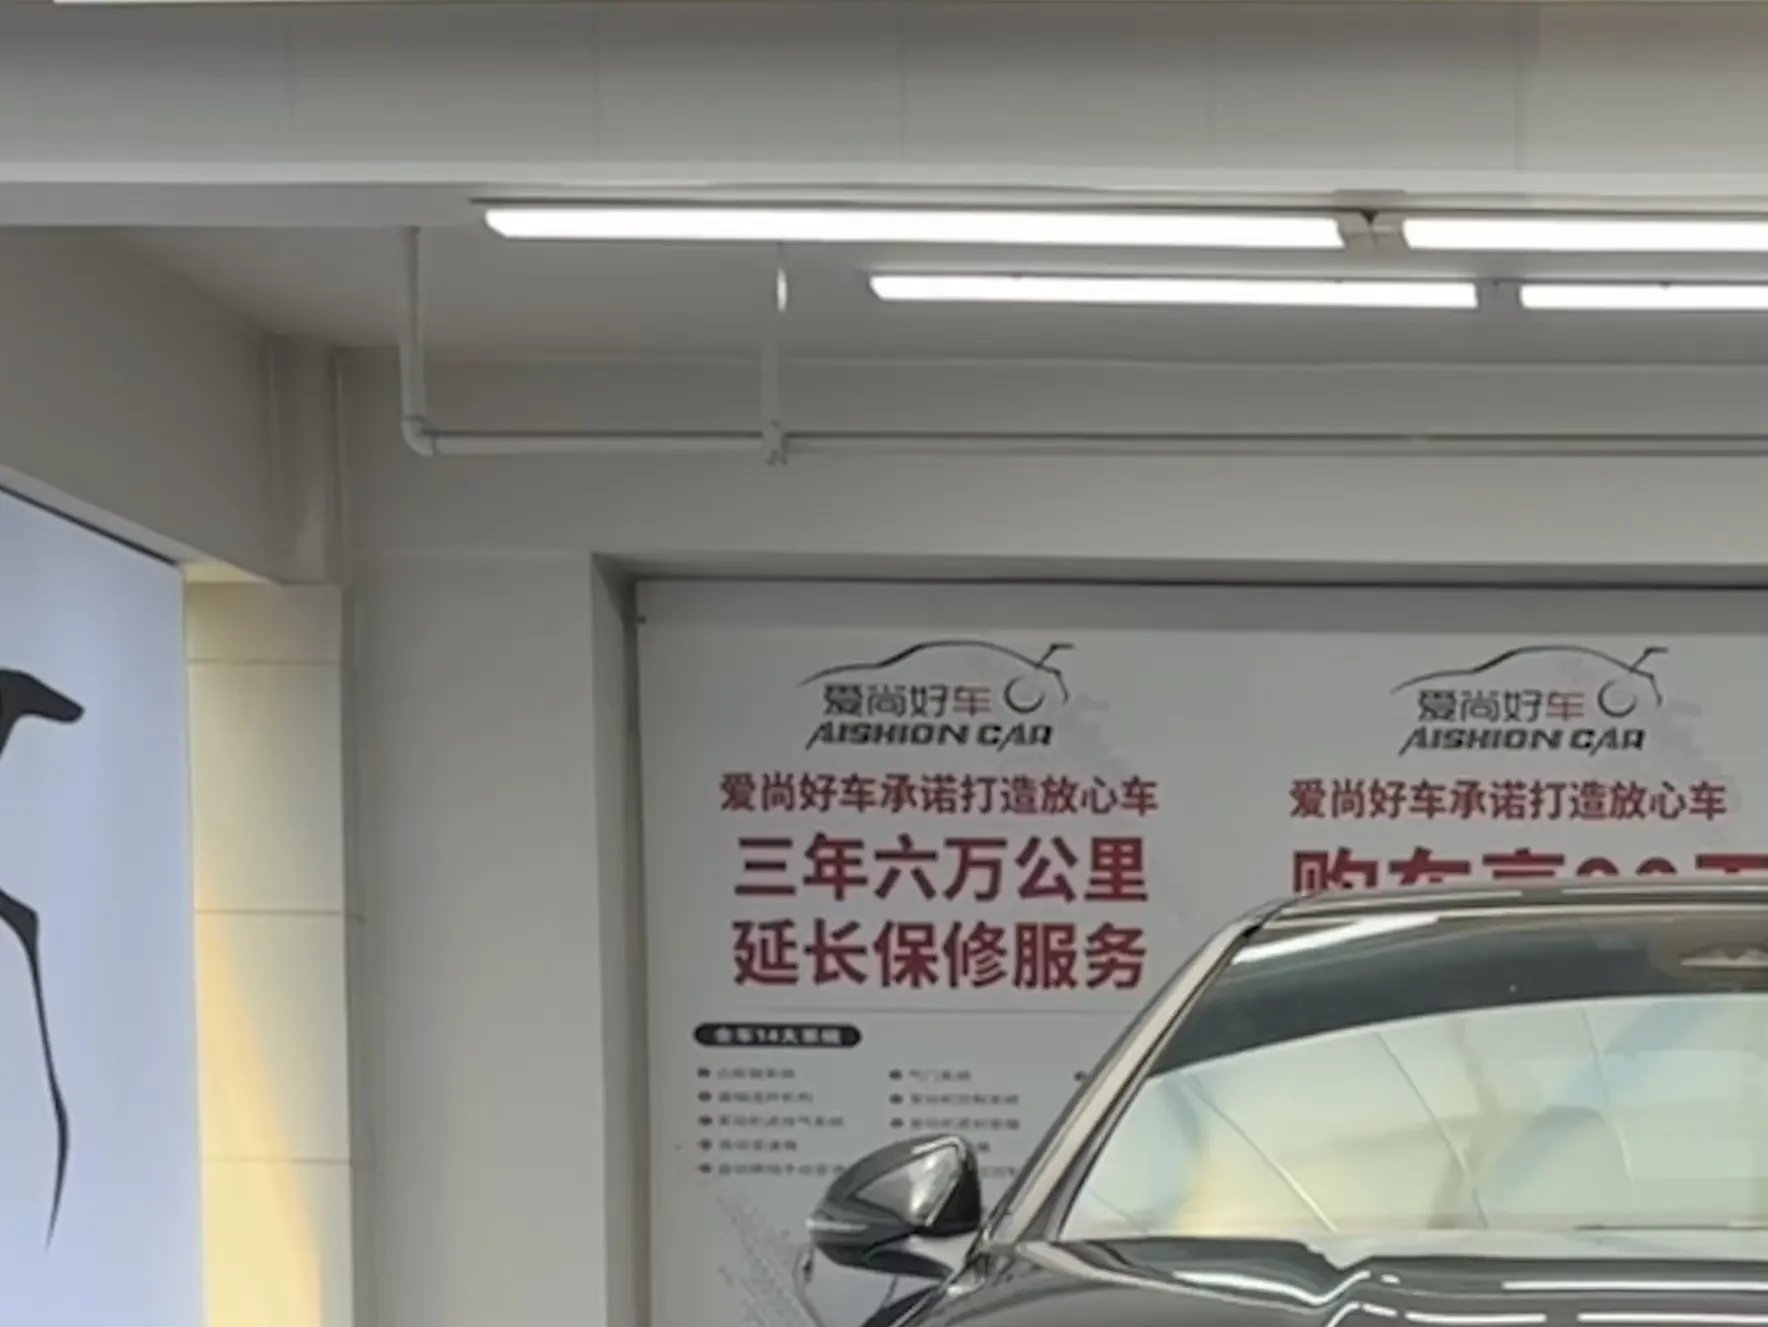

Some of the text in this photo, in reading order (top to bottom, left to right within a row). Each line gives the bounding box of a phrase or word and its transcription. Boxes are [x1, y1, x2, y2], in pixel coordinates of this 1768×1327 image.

[824, 684, 989, 717] 爱尚好车
[1419, 690, 1583, 723] 爱尚好车
[806, 721, 1053, 751] AISHION CAR
[1399, 727, 1645, 756] AISHION CAR
[719, 772, 1158, 816] 爱尚好车承诺打造放心车
[1289, 778, 1727, 820] 爱尚好车承诺打造放心车
[734, 831, 1149, 903] 三年六万公里
[732, 917, 1147, 990] 延长保修服务
